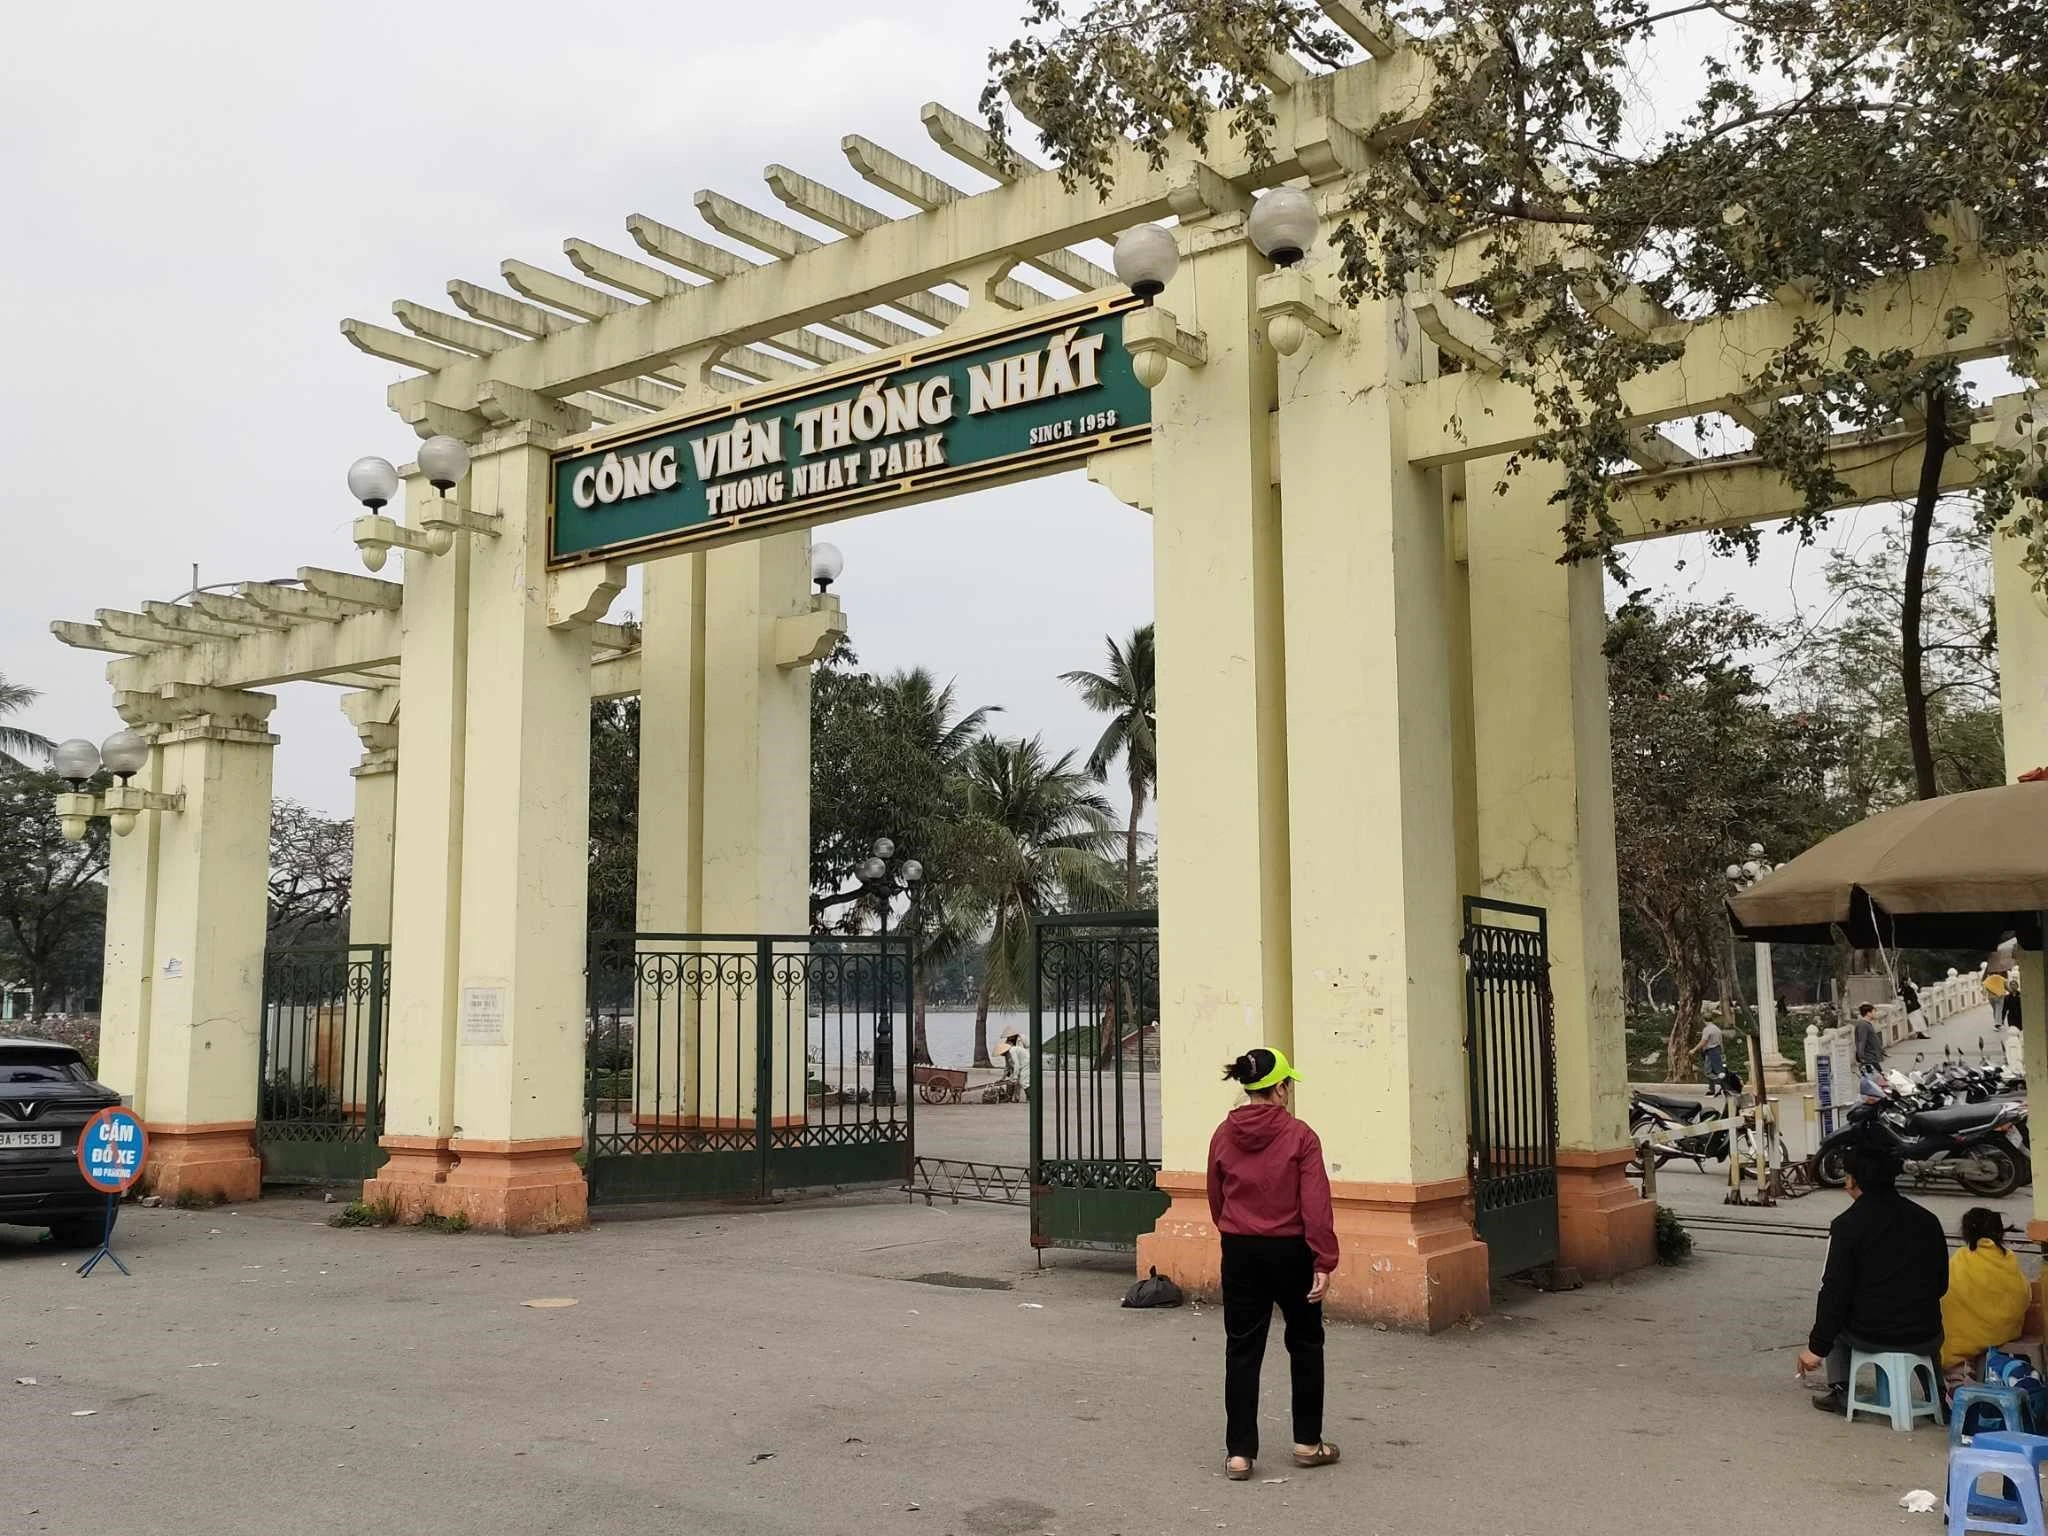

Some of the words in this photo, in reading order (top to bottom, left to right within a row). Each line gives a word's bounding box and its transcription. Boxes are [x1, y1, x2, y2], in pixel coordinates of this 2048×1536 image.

[572, 446, 678, 509] CÔNG
[688, 417, 783, 481] VIÊN
[793, 376, 954, 456] THỐNG
[967, 327, 1105, 415] NHẤT
[1029, 418, 1072, 446] SINCE
[1079, 409, 1117, 433] 1958
[706, 471, 784, 516] THONG
[791, 453, 862, 498] NHAT
[869, 432, 946, 480] PARK
[99, 1119, 134, 1142] CẤM
[116, 1149, 136, 1165] XE
[92, 1167, 103, 1177] NO
[103, 1168, 131, 1178] PARKING
